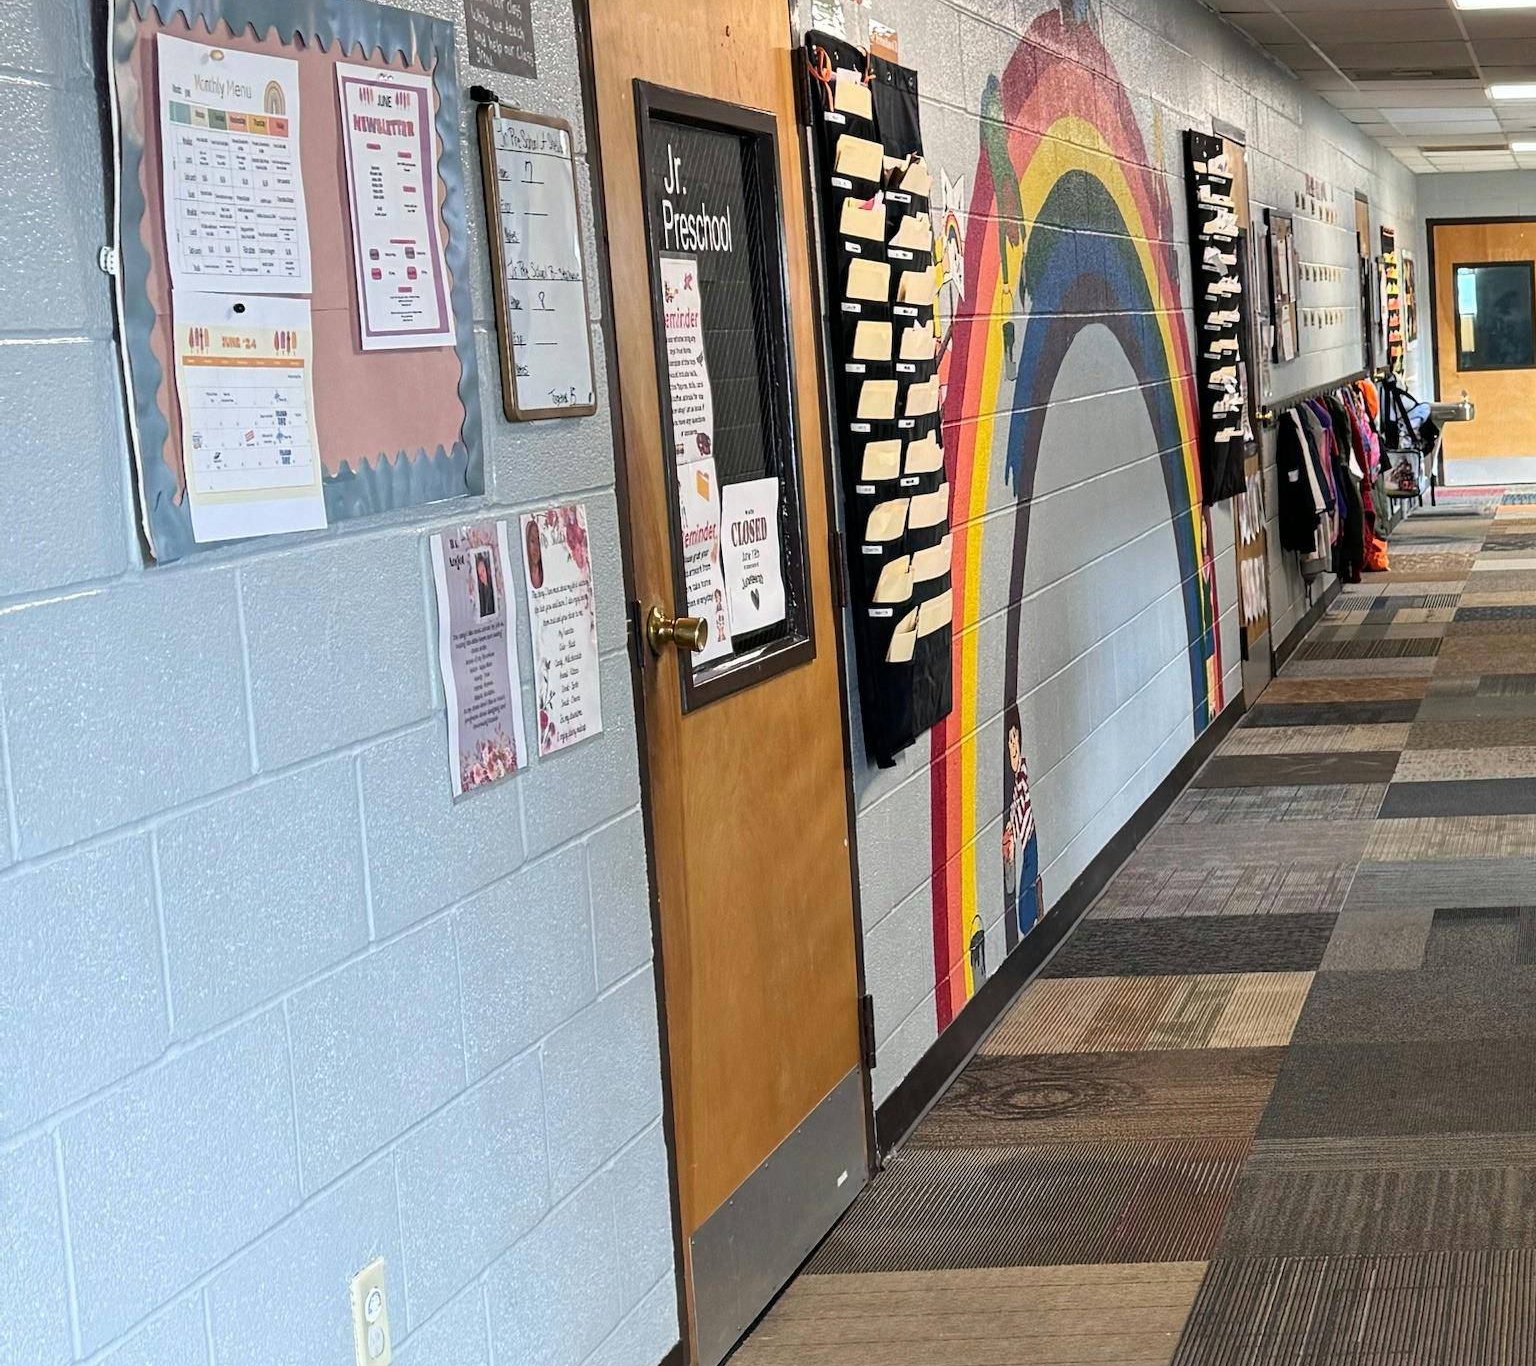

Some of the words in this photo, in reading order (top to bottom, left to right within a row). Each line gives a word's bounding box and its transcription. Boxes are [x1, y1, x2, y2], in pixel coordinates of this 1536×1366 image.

[227, 80, 252, 99] Menu
[353, 114, 414, 137] NEWSLETTER
[664, 143, 687, 195] Jr.
[662, 199, 732, 252] Preschool
[730, 517, 768, 547] CLOSED
